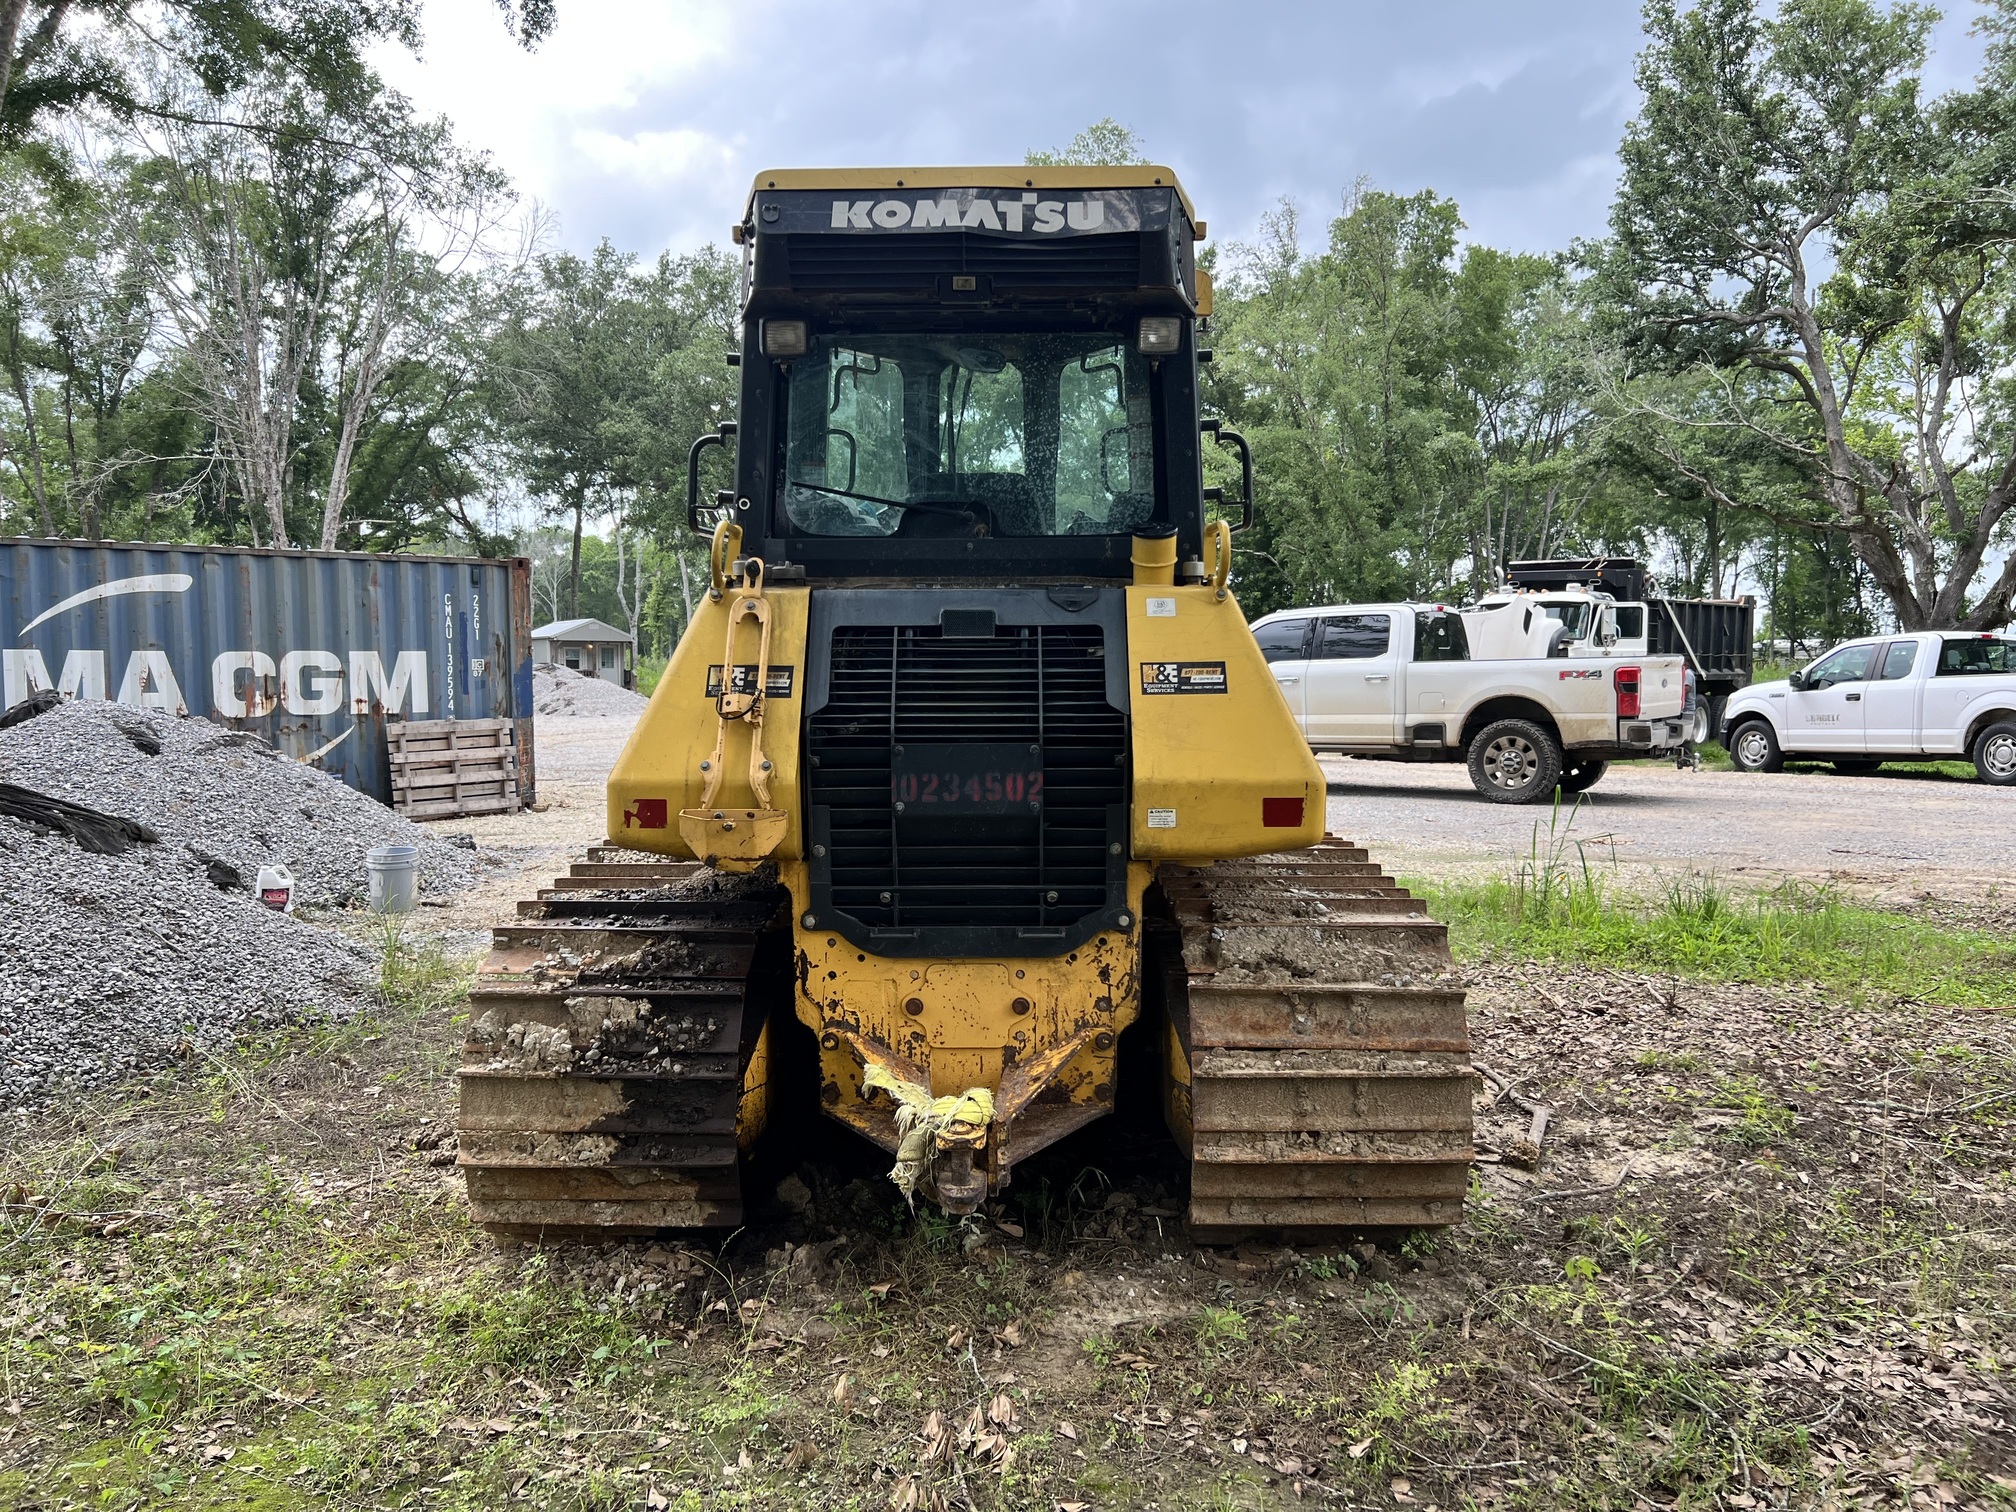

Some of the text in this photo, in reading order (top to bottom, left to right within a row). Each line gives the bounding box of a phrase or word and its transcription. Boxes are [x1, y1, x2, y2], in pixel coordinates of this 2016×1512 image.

[831, 192, 1105, 233] KOMATSU
[444, 593, 453, 639] CMAU
[211, 650, 429, 718] CGM
[1142, 664, 1178, 683] H&E
[1559, 670, 1603, 681] FX4
